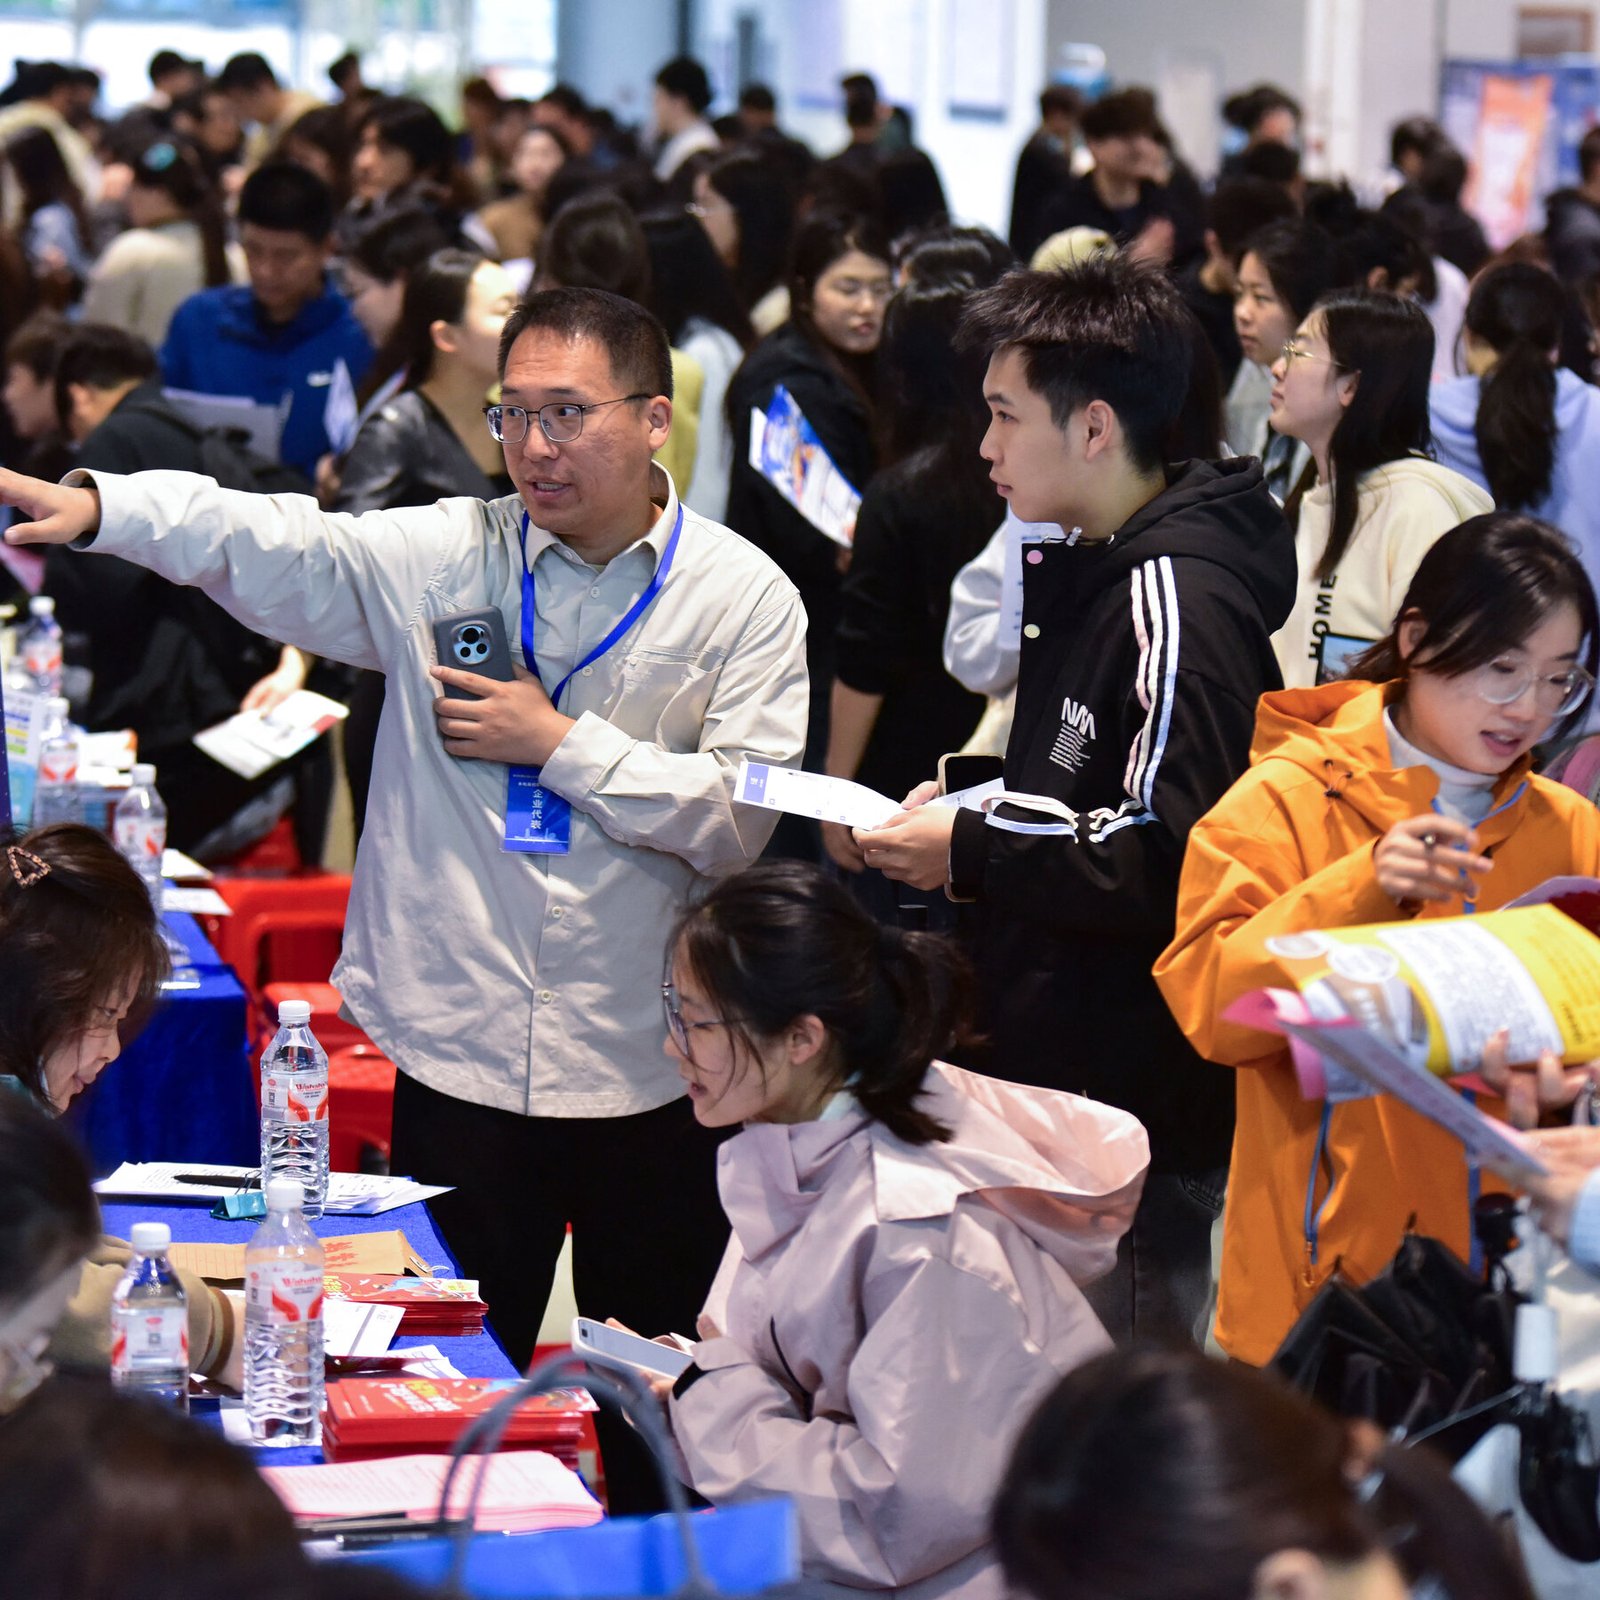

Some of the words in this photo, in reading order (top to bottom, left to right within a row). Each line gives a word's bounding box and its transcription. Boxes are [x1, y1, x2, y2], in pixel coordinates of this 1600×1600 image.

[1308, 575, 1338, 660] HOME
[530, 789, 544, 830] 企业代表
